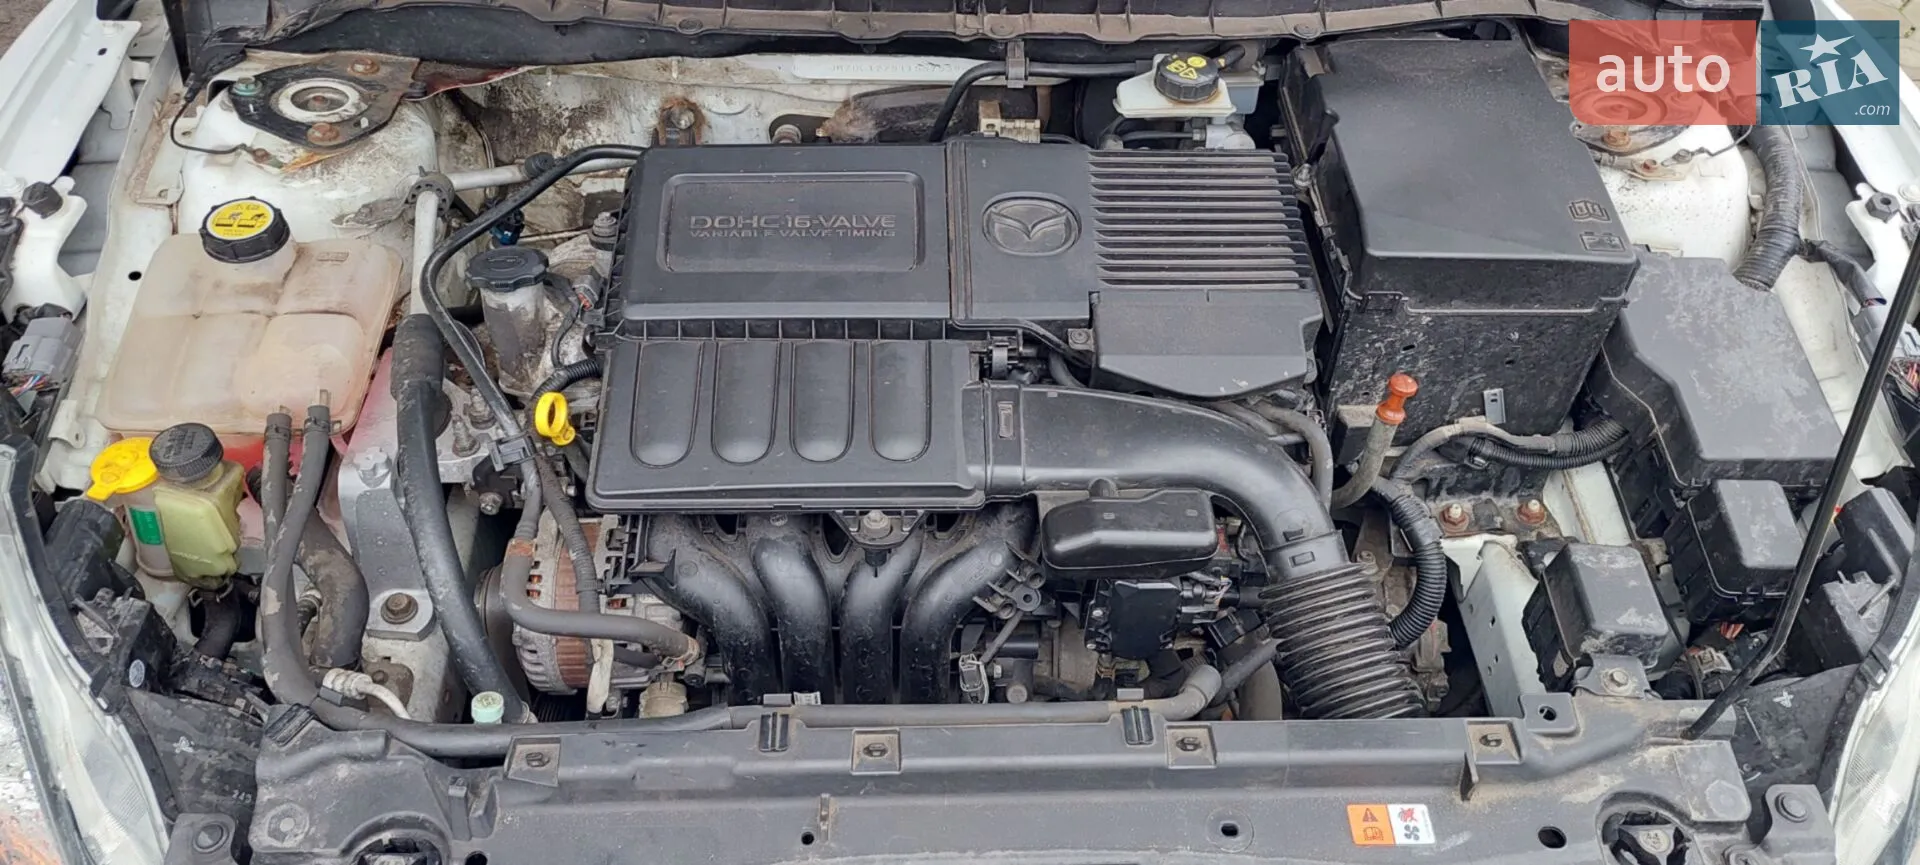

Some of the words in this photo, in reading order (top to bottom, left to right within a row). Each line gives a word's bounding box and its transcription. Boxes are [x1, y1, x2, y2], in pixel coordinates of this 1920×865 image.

[690, 214, 780, 229] DOHC
[779, 228, 833, 238] VALVE
[835, 228, 896, 238] TIMING
